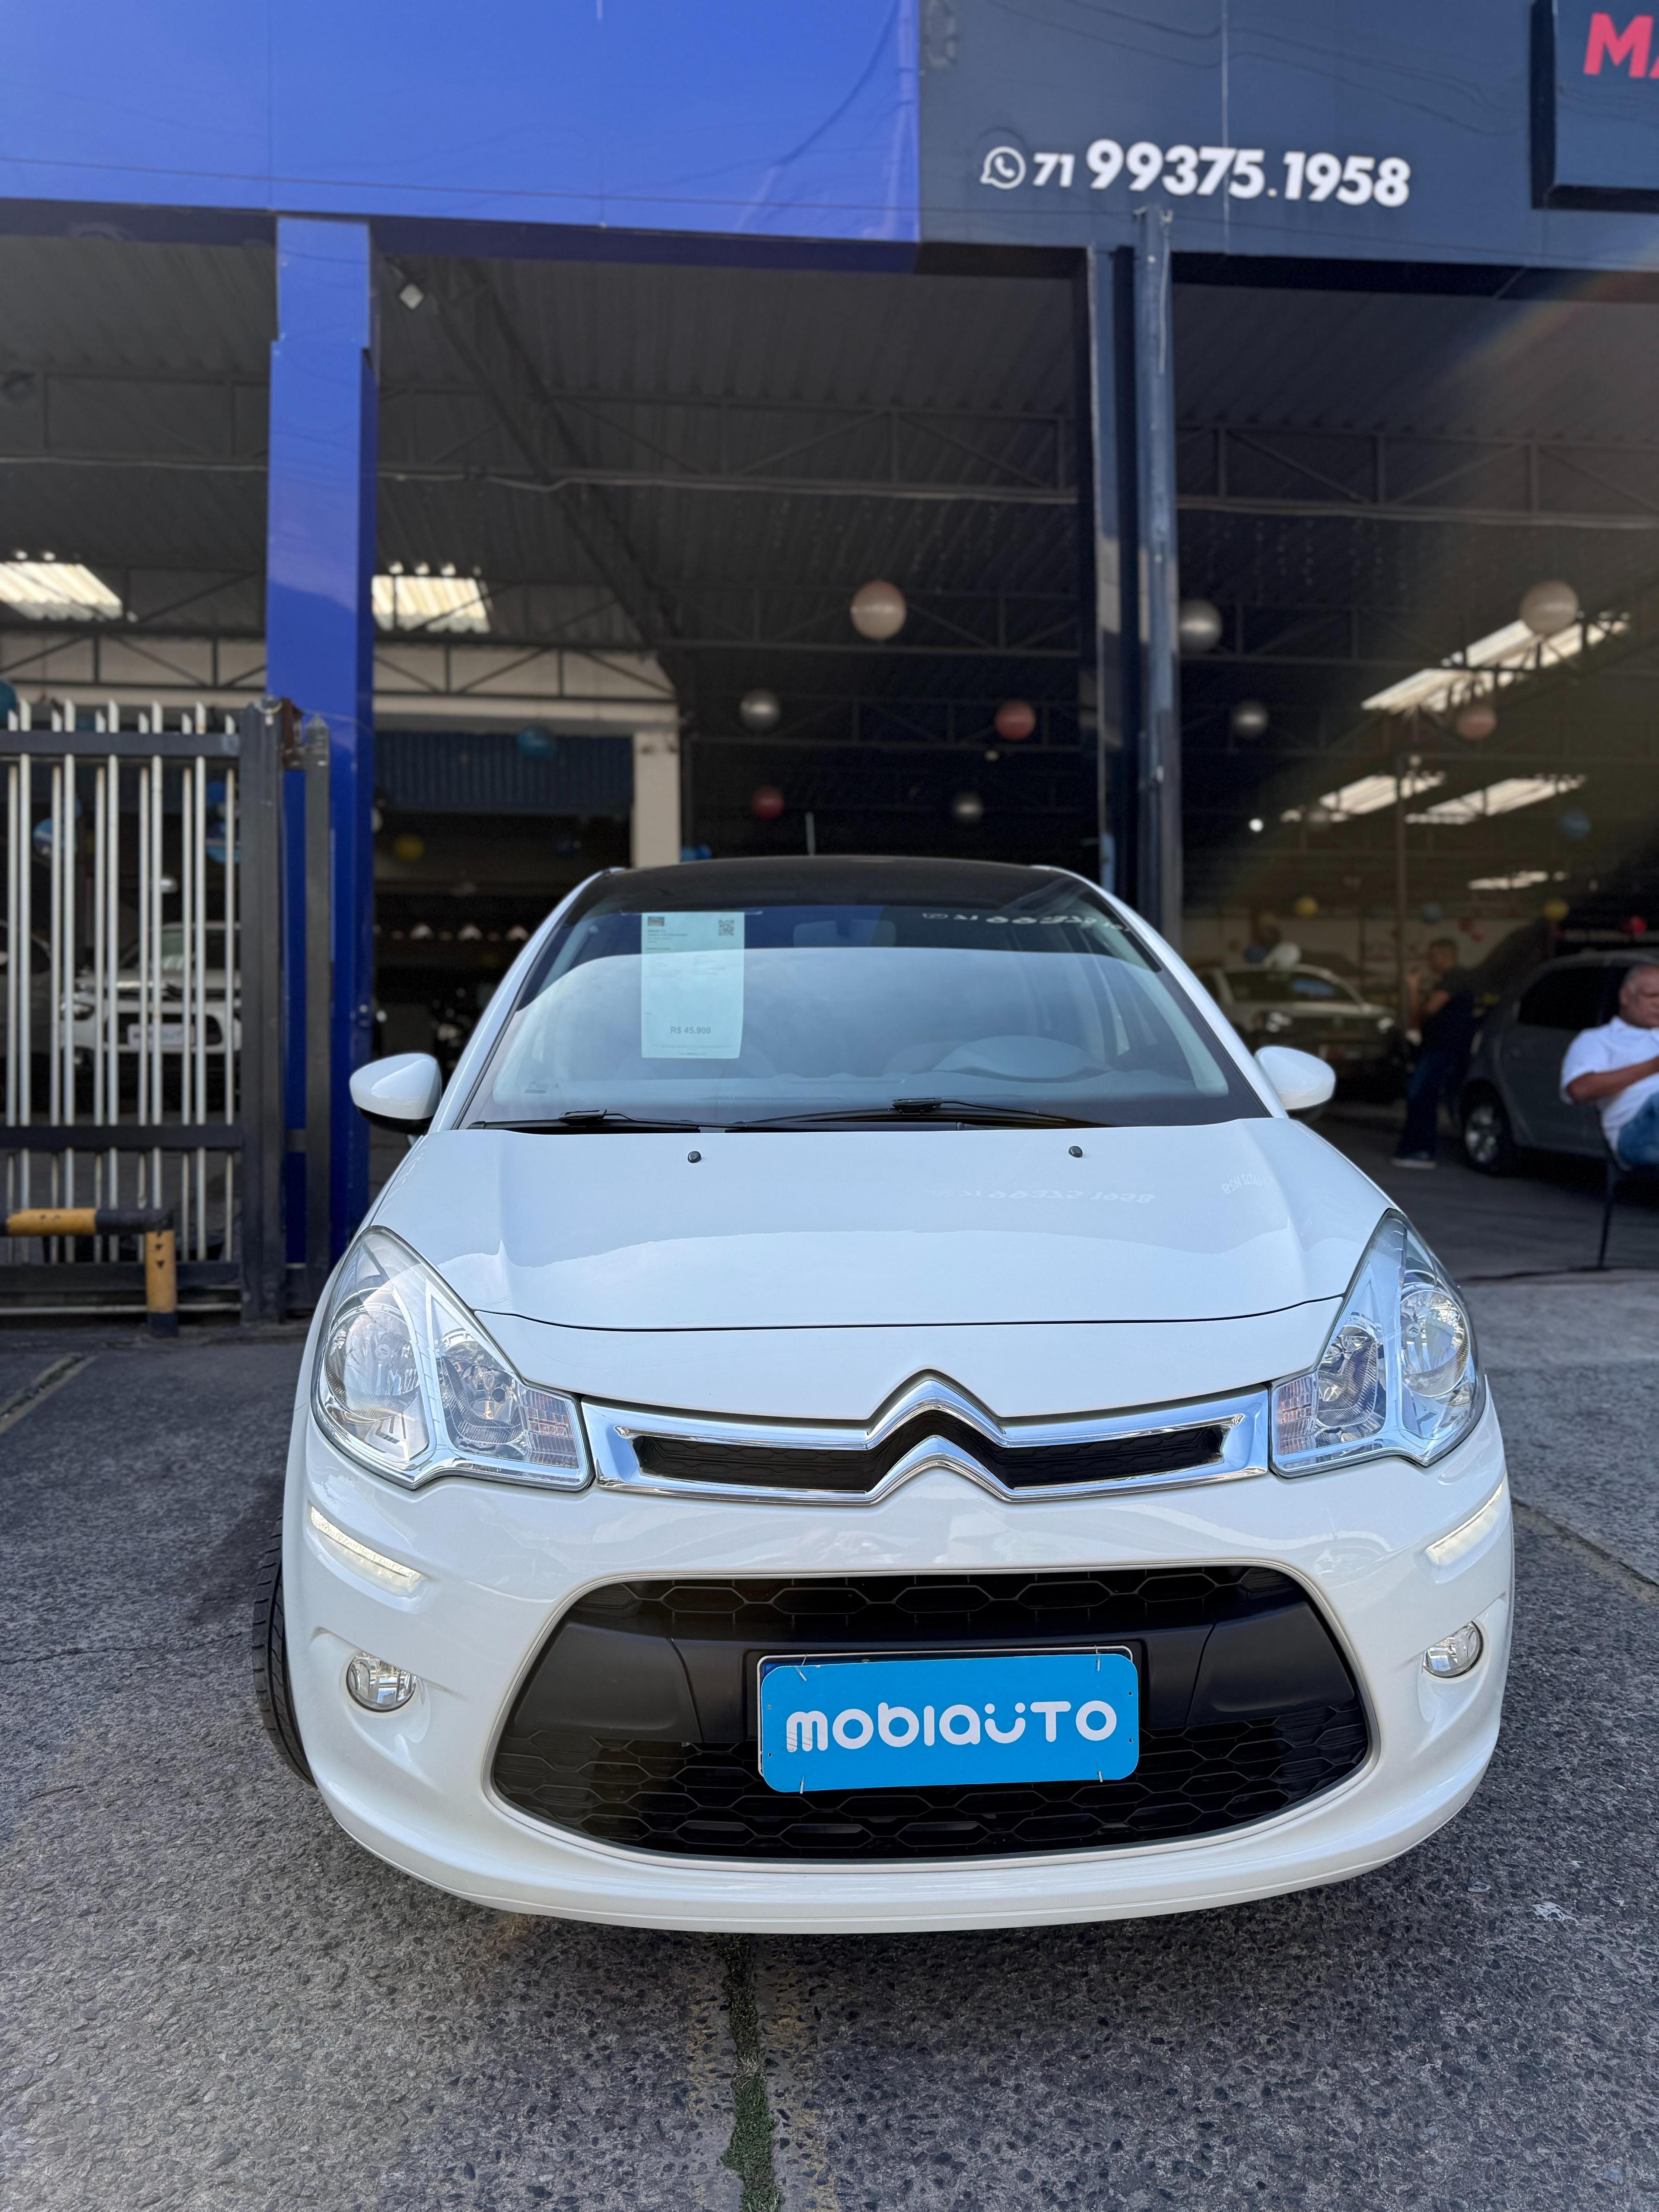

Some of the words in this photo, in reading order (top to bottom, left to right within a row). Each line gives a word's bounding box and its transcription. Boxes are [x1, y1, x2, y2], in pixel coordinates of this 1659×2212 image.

[1583, 12, 1659, 78] M
[1033, 153, 1074, 188] 71
[1086, 138, 1411, 208] 99375.1958
[670, 1027, 682, 1035] R$
[683, 1026, 711, 1034] 45.900
